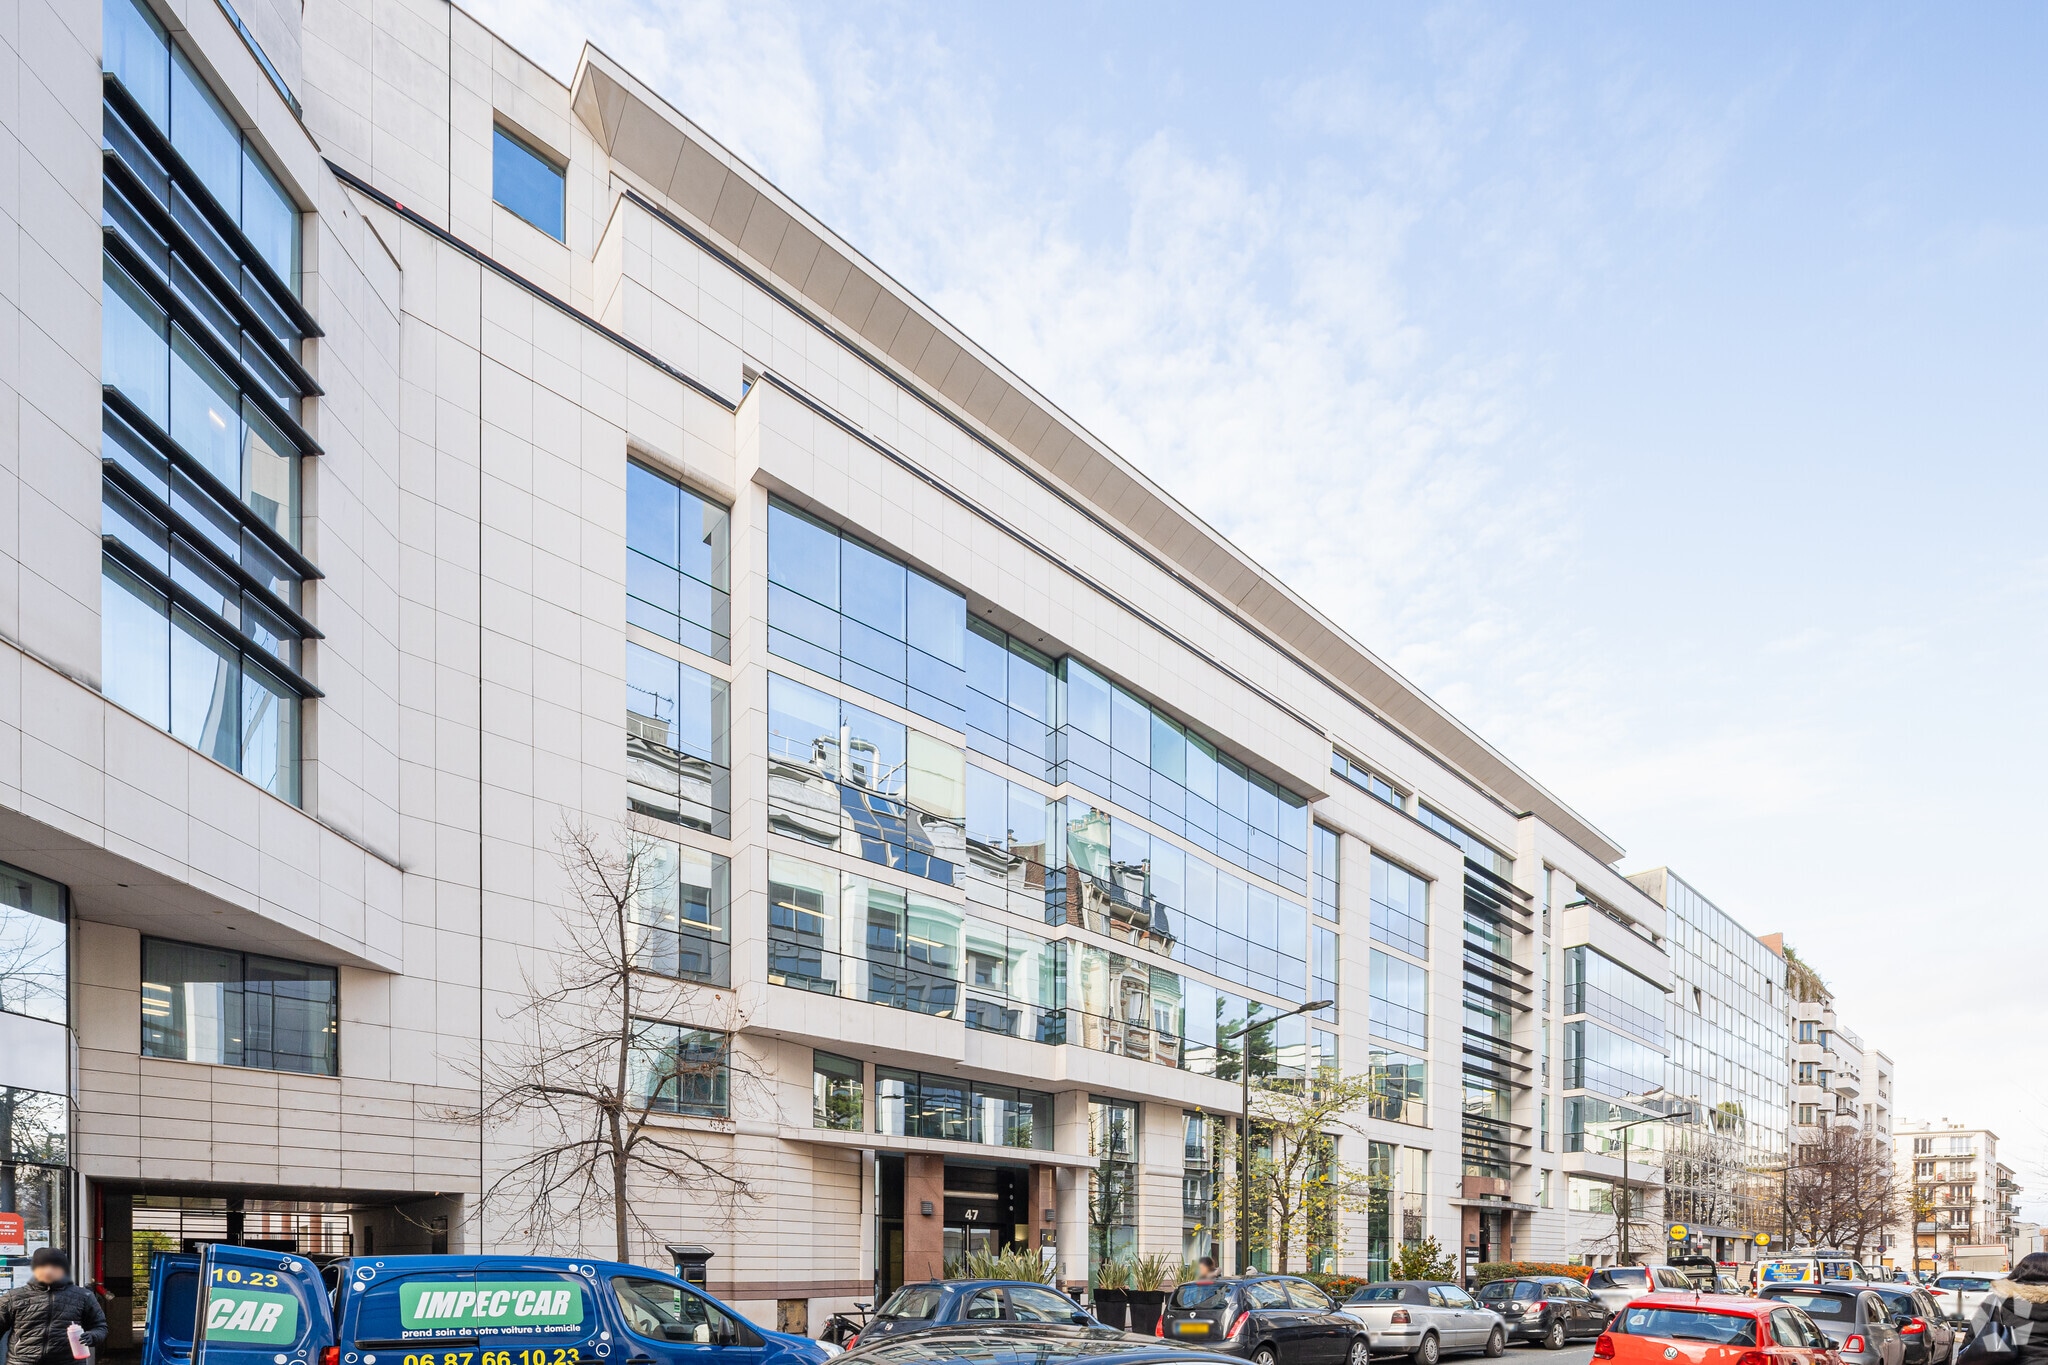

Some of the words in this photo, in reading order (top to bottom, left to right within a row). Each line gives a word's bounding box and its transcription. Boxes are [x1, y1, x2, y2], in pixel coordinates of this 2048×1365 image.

[965, 1209, 979, 1220] 47
[213, 1268, 279, 1288] 10.23
[413, 1290, 572, 1319] IMPEC'CAR
[401, 1328, 433, 1340] prend
[435, 1327, 456, 1337] soin
[459, 1327, 472, 1336] de
[474, 1326, 499, 1335] votre
[501, 1325, 534, 1334] voiture
[535, 1325, 542, 1333] à
[543, 1323, 581, 1333] domicile
